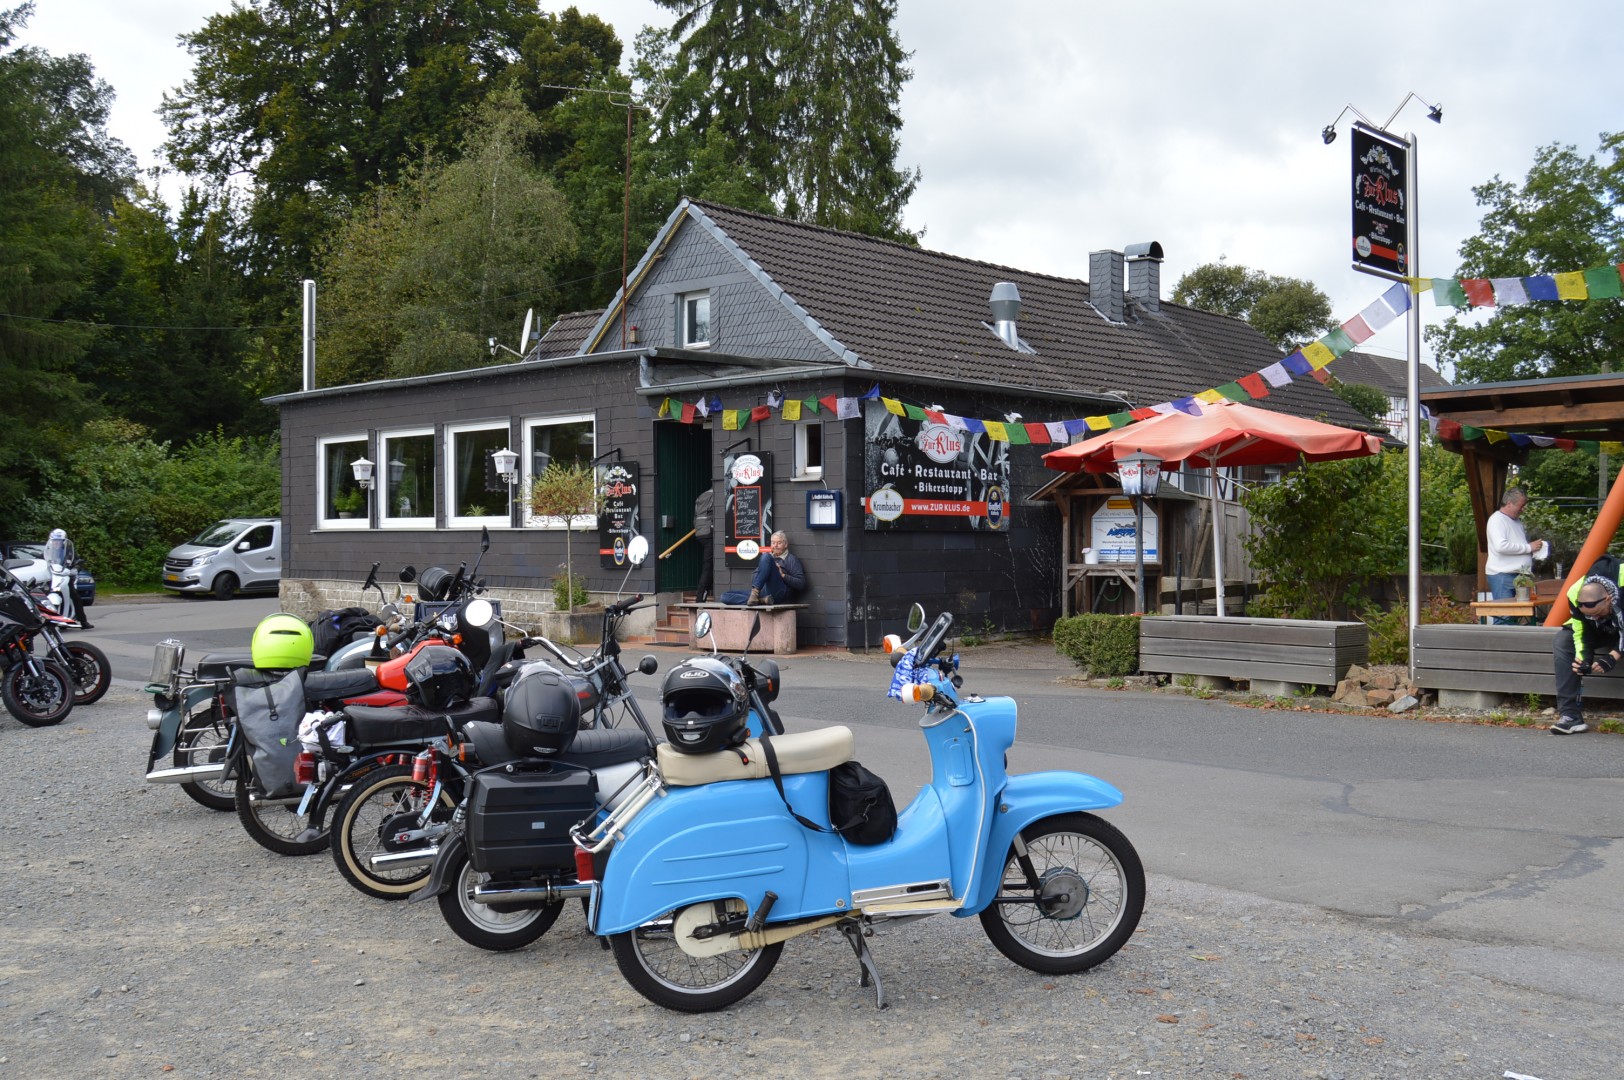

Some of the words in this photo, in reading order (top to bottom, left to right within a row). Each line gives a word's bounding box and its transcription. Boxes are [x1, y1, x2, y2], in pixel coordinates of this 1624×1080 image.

[1375, 175, 1399, 206] Klus
[935, 431, 961, 455] Klus
[743, 465, 762, 480] Klus
[881, 462, 904, 477] Café
[915, 464, 971, 480] Restaurant
[980, 468, 998, 481] Bar
[614, 481, 632, 498] Klus
[918, 481, 963, 494] Bikerstopp
[873, 500, 902, 512] Krombacher
